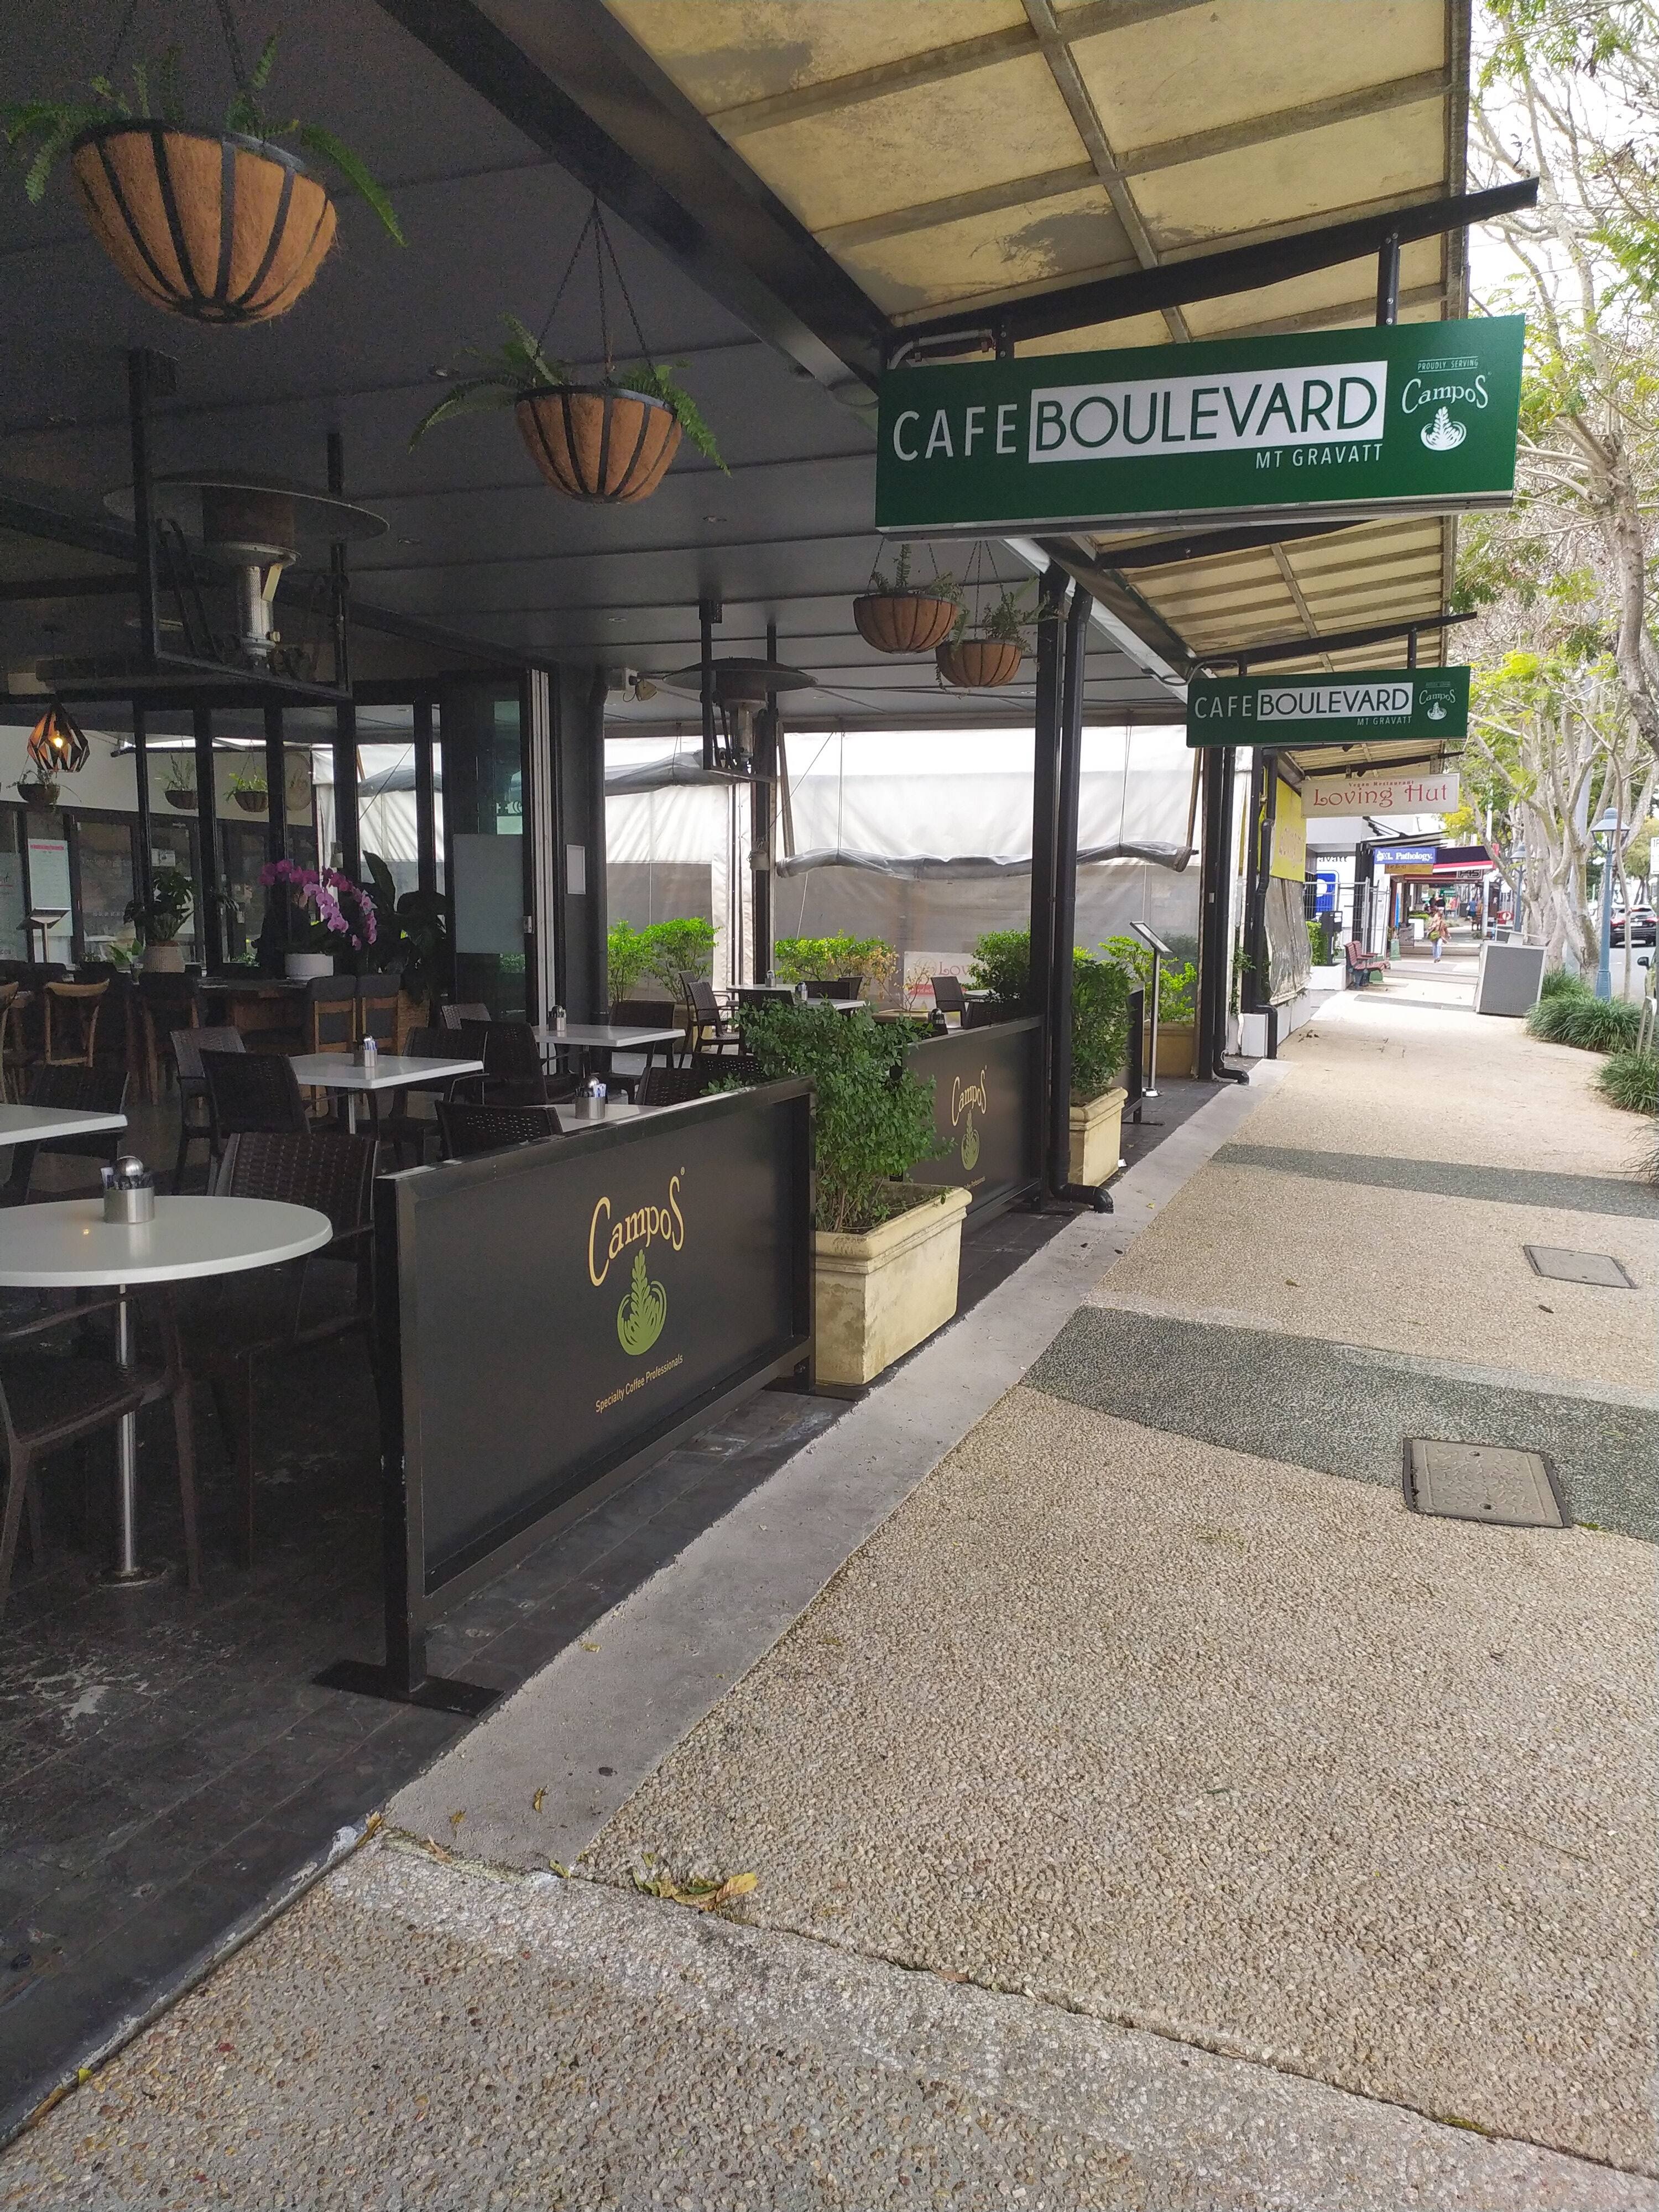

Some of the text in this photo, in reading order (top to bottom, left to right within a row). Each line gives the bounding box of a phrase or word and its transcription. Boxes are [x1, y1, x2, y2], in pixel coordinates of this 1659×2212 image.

[1417, 358, 1479, 371] PROUDLY SERVING
[893, 377, 1378, 462] CAFE BOULEVARD
[1255, 444, 1384, 469] MT GRAVATT
[1194, 688, 1410, 719] CAFE BOULEVARD
[1373, 716, 1412, 726] GRAVATT
[1313, 784, 1448, 808] Loving Hut
[595, 1353, 684, 1413] Specialty Coffee Professionals
